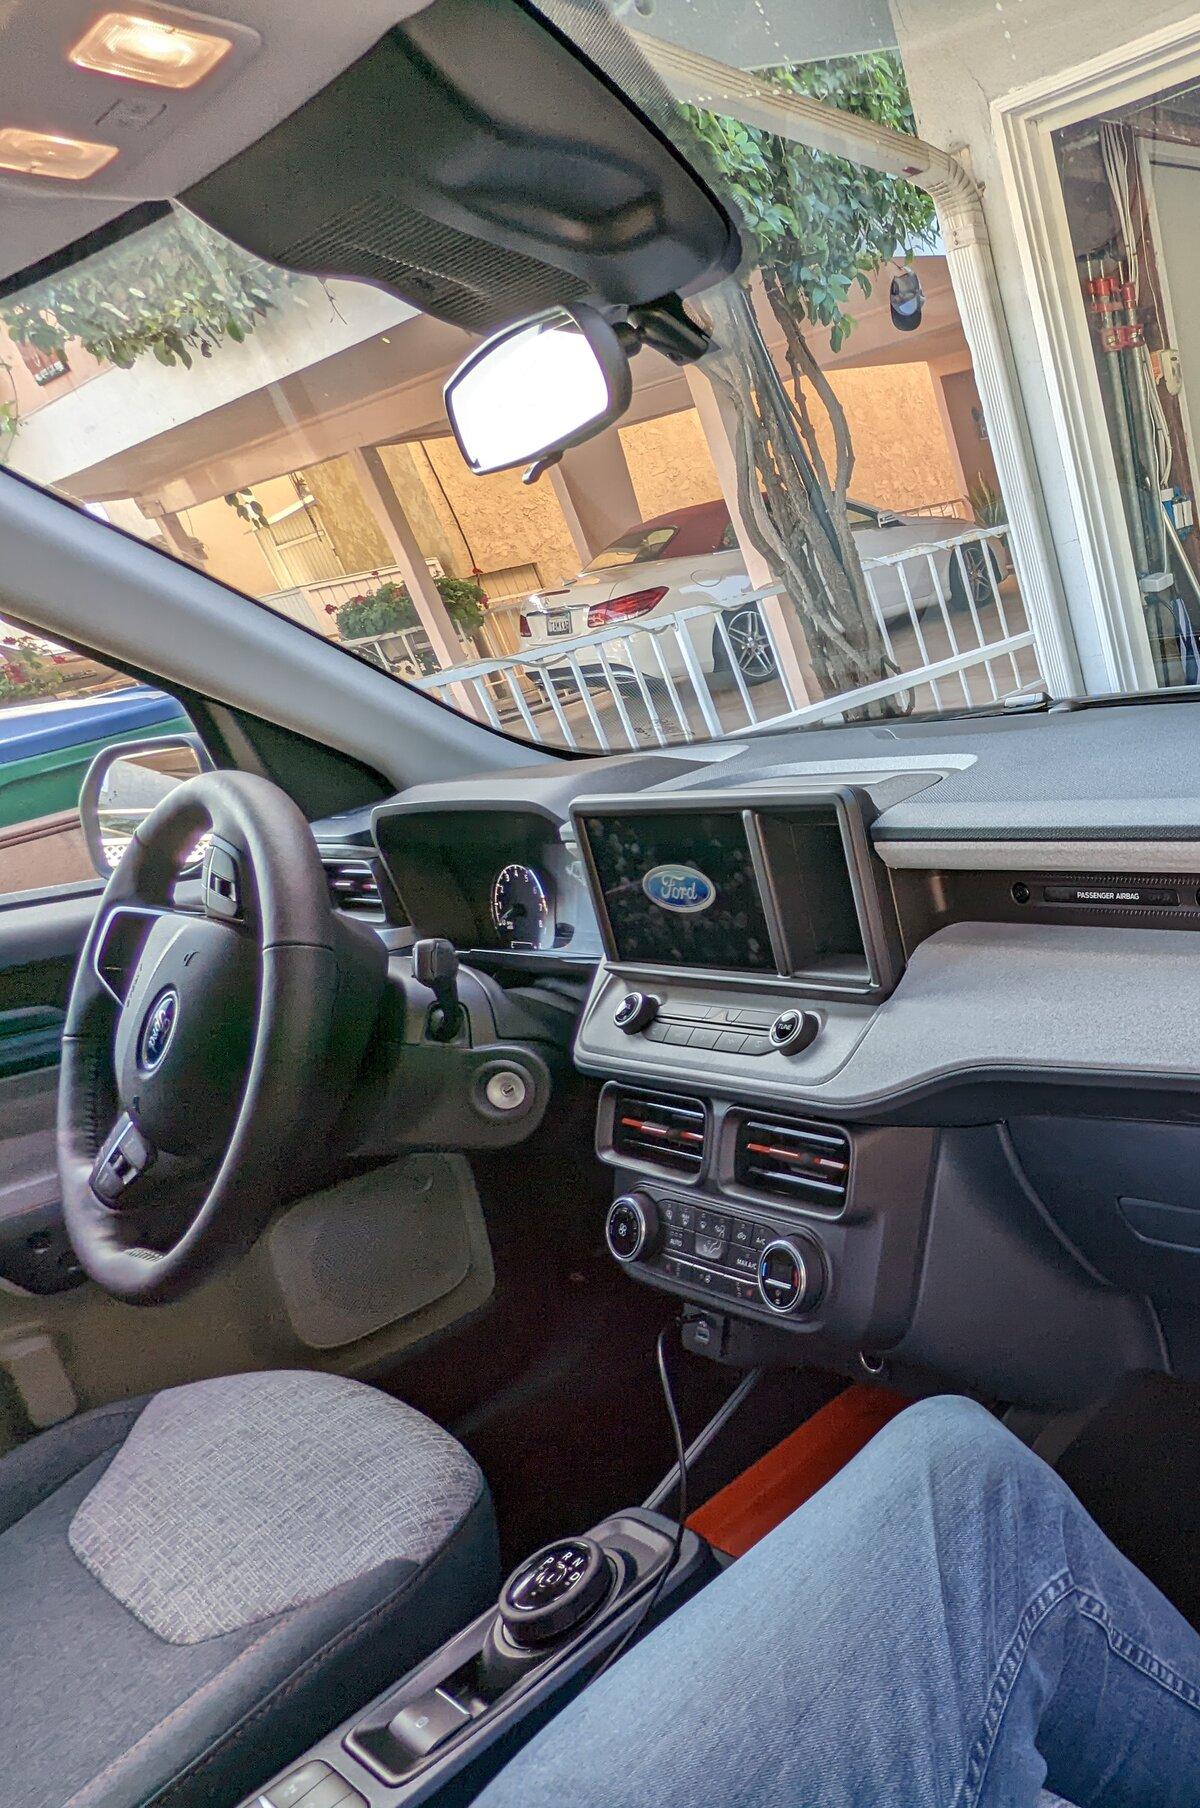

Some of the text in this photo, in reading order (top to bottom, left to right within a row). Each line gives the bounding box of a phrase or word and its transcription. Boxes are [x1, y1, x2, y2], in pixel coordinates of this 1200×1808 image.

[660, 874, 698, 900] Ford
[1077, 891, 1140, 900] PASSENGER AIRBAG
[148, 1009, 170, 1054] Ford
[778, 1023, 793, 1031] TUNE
[561, 1551, 573, 1561] R
[540, 1556, 554, 1569] P
[572, 1557, 584, 1568] N
[569, 1571, 581, 1581] D
